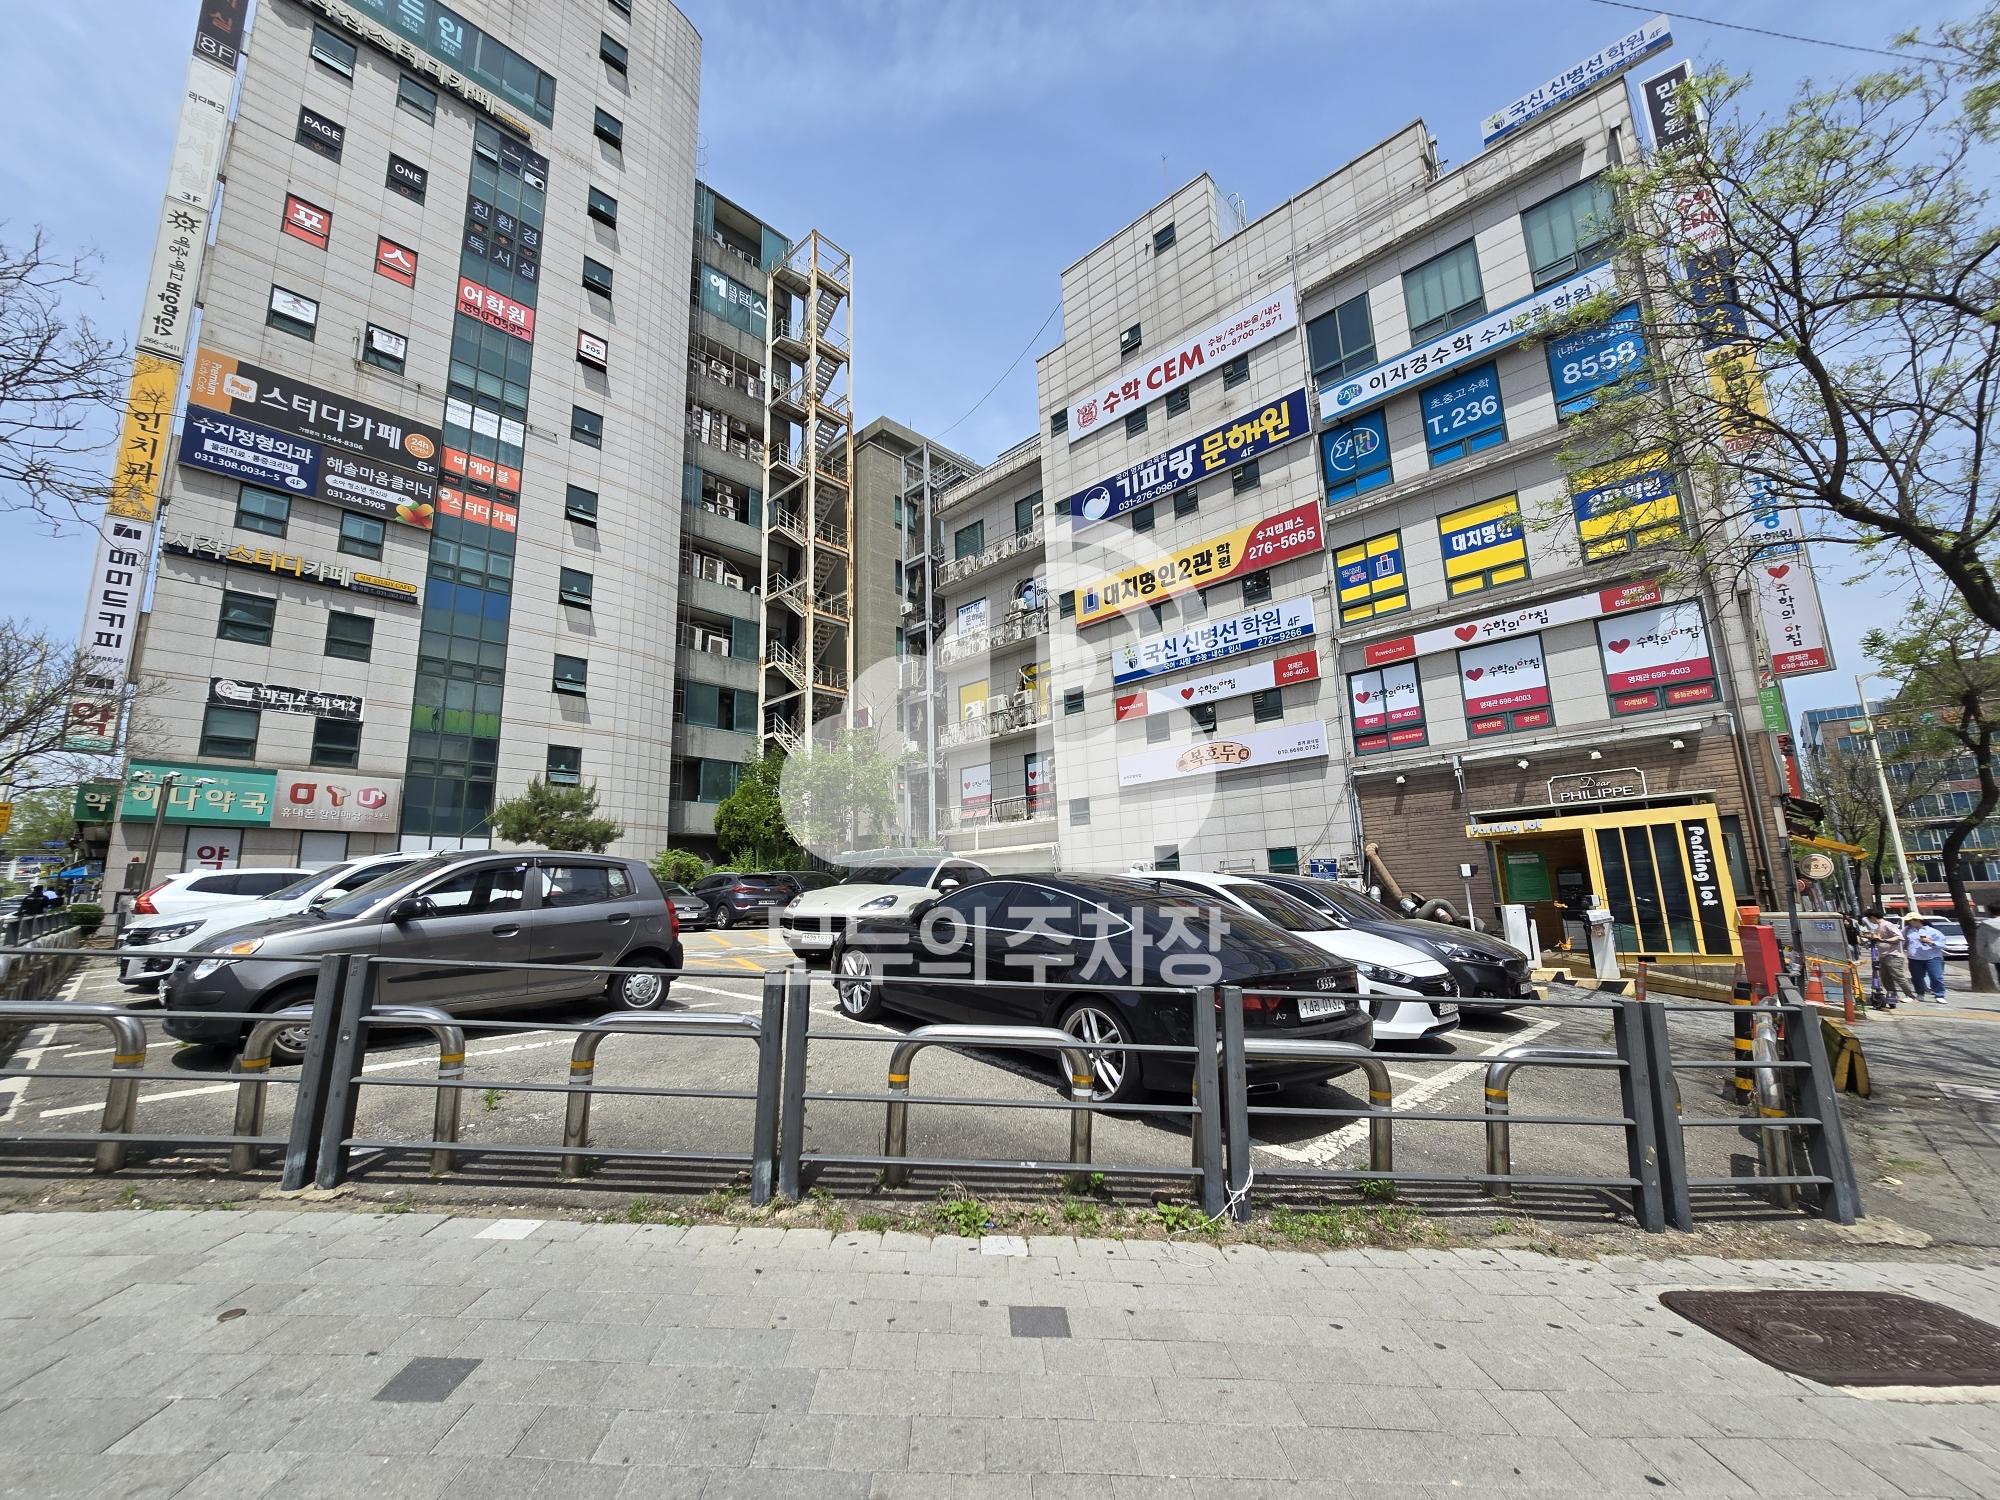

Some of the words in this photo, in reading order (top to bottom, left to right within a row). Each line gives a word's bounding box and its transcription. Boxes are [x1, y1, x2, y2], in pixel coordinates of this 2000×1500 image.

[199, 35, 234, 59] 8F
[1601, 47, 1648, 77] 272-9266
[1508, 88, 1544, 117] 국신
[1548, 53, 1605, 96] 신병선
[1605, 29, 1646, 61] 학원
[1649, 27, 1663, 40] 4F
[303, 115, 341, 142] PAGE
[394, 163, 423, 184] ONE
[181, 191, 202, 204] 3F
[293, 203, 324, 230] 포
[383, 249, 412, 268] 스
[472, 201, 538, 246] 친환경
[467, 235, 536, 280] 독서실
[153, 281, 181, 336] 바우하우스
[463, 285, 527, 327] 어학원
[1207, 301, 1281, 347] 수능/수리논술/내신
[1209, 313, 1282, 357] 010-8700-3871
[1368, 332, 1473, 390] 이자경수학
[1551, 283, 1594, 310] 학원
[143, 336, 180, 353] 266-5411
[207, 361, 223, 396] Premium
[1102, 378, 1141, 414] 수학
[1146, 343, 1205, 390] CEM
[1467, 377, 1490, 392] 수학
[259, 386, 402, 451] 스터디카페
[192, 416, 314, 465] 수지정형외과
[322, 433, 364, 451] 1544-8306
[410, 437, 429, 451] 24h
[1201, 400, 1290, 471] 문해원
[416, 460, 436, 473] 5F
[1240, 446, 1255, 459] 4F
[194, 451, 280, 482] 031.308.0034~5
[289, 477, 303, 488] 4F
[326, 456, 433, 499] 해솔마음클리닉
[1116, 443, 1197, 498] 기파랑
[326, 488, 387, 511] 031.264.3905
[1118, 478, 1179, 511] 031-276-0987
[109, 504, 152, 520] 266-2875
[448, 497, 517, 527] 스터디카페
[1255, 516, 1304, 541] 수지캠퍼스
[1451, 520, 1514, 553] 대치명인
[1248, 527, 1316, 561] 276-5665
[166, 531, 350, 588] 시작스터디카페
[1103, 551, 1213, 606] 대치명인2관
[1216, 542, 1232, 569] 학원
[93, 548, 138, 650] 매머드커피
[1142, 637, 1178, 663] 국신
[1182, 620, 1238, 653] 신병선
[1241, 607, 1282, 637] 학원
[1286, 615, 1301, 628] 4F
[1257, 627, 1302, 646] 272-9266
[1282, 667, 1309, 678] 698-4003
[1651, 666, 1691, 679] 698-4003
[1780, 658, 1819, 671] 698-4003
[1391, 709, 1417, 719] 698-4003
[1499, 694, 1532, 705] 698-4003
[1189, 744, 1237, 767] 복호두
[1560, 785, 1635, 803] PHILIPPE
[1579, 776, 1611, 790] Dear
[84, 791, 113, 812] 약
[131, 785, 270, 815] 하나약국
[280, 806, 316, 820] 휴대폰
[1470, 821, 1521, 835] Parking
[1522, 819, 1543, 831] lot
[196, 844, 229, 871] 약
[1688, 826, 1710, 884] Parking
[1699, 885, 1719, 907] lot
